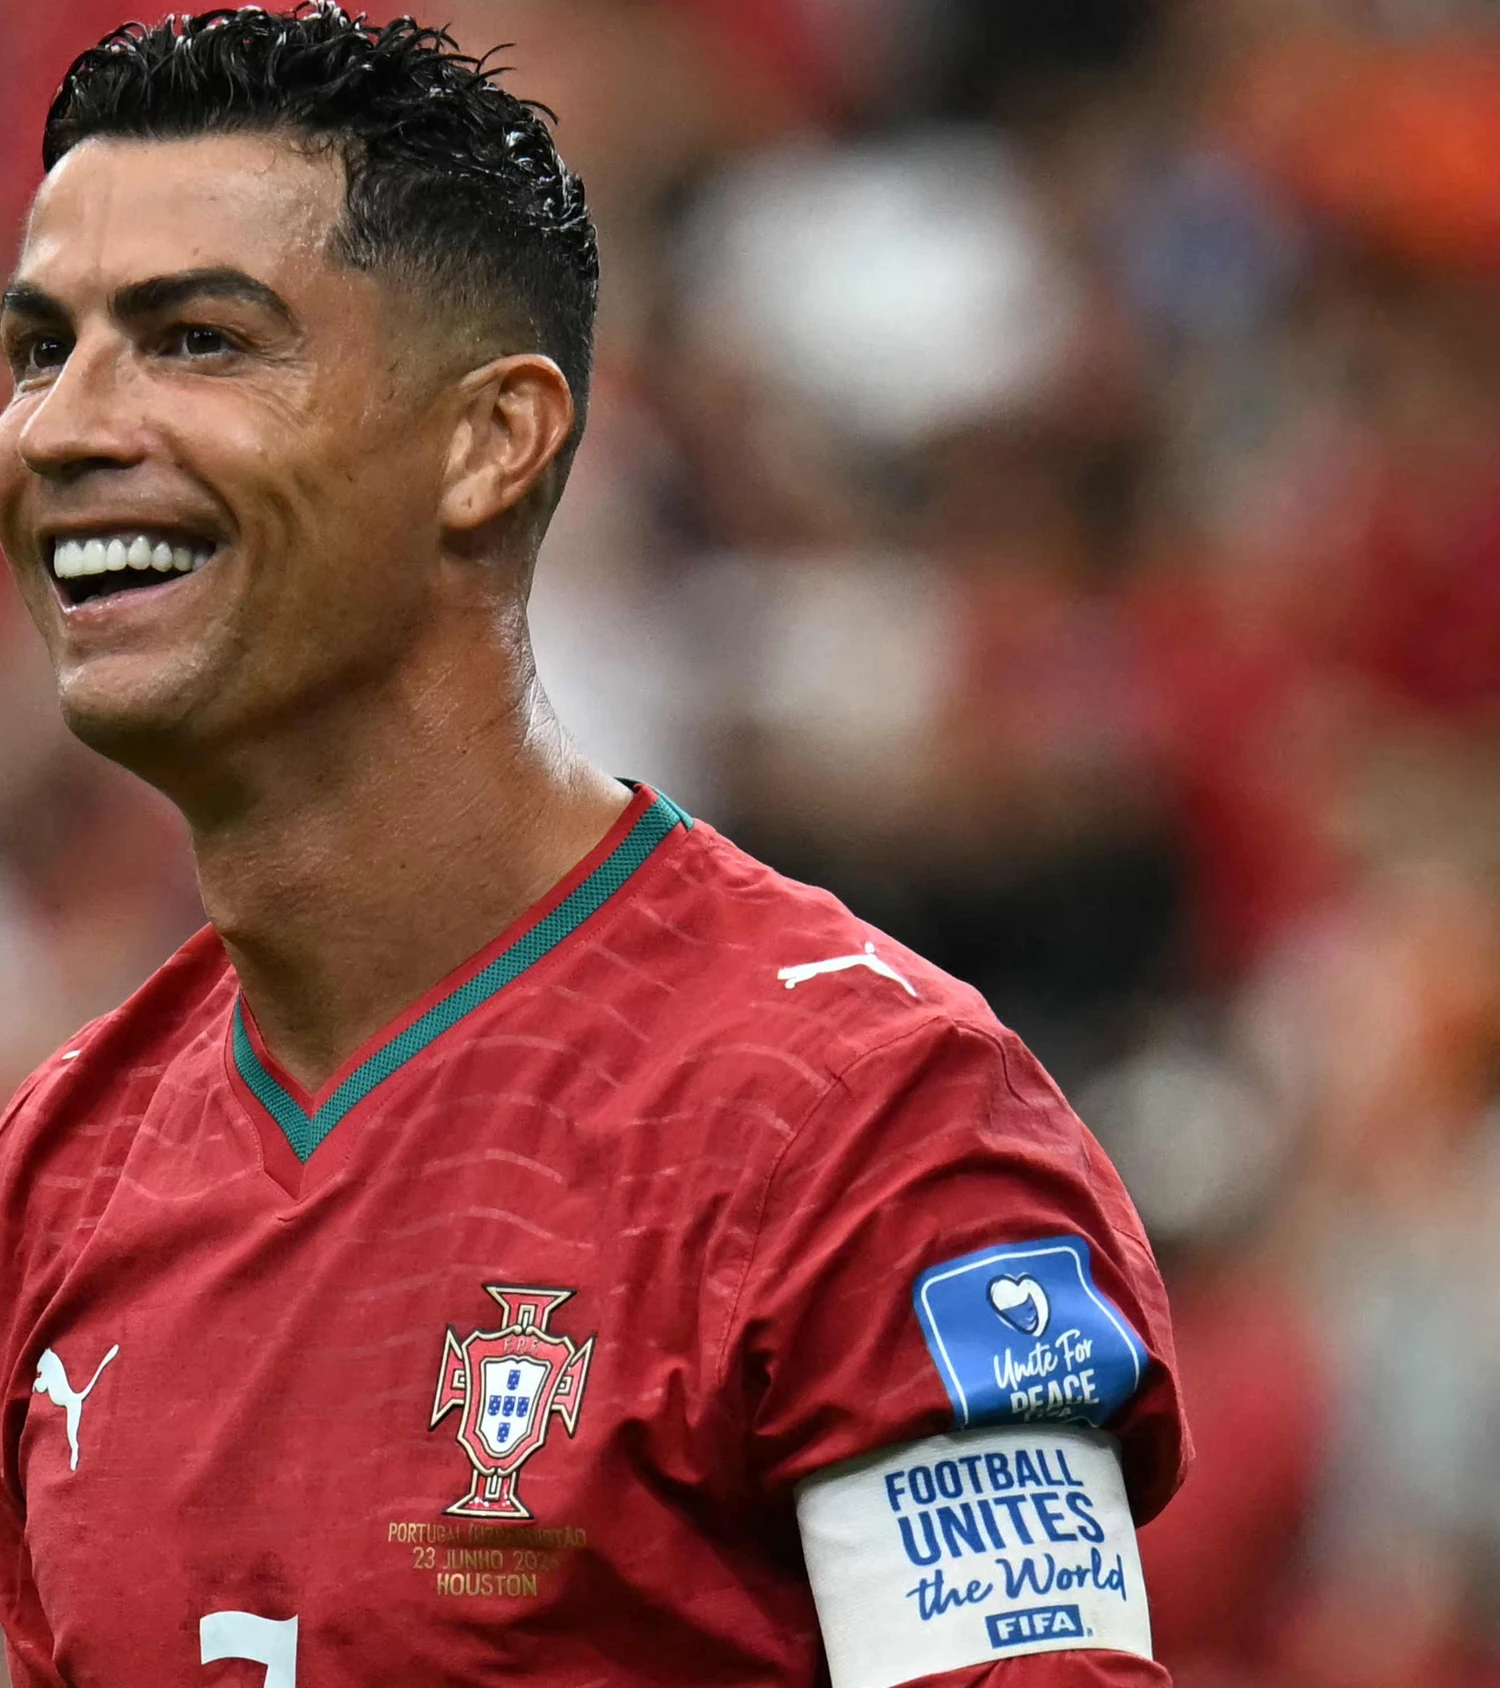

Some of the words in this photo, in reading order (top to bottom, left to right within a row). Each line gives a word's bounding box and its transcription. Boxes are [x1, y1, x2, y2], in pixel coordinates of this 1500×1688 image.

[993, 1342, 1059, 1391] Unite
[1055, 1329, 1093, 1372] For
[885, 1449, 1084, 1512] FOOTBALL
[413, 1546, 436, 1569] 23
[442, 1549, 503, 1570] JUNHO
[898, 1492, 1105, 1566] UNITES
[437, 1573, 537, 1597] HOUSTON
[906, 1569, 993, 1621] the
[995, 1547, 1127, 1601] World
[996, 1611, 1077, 1640] FIFA
